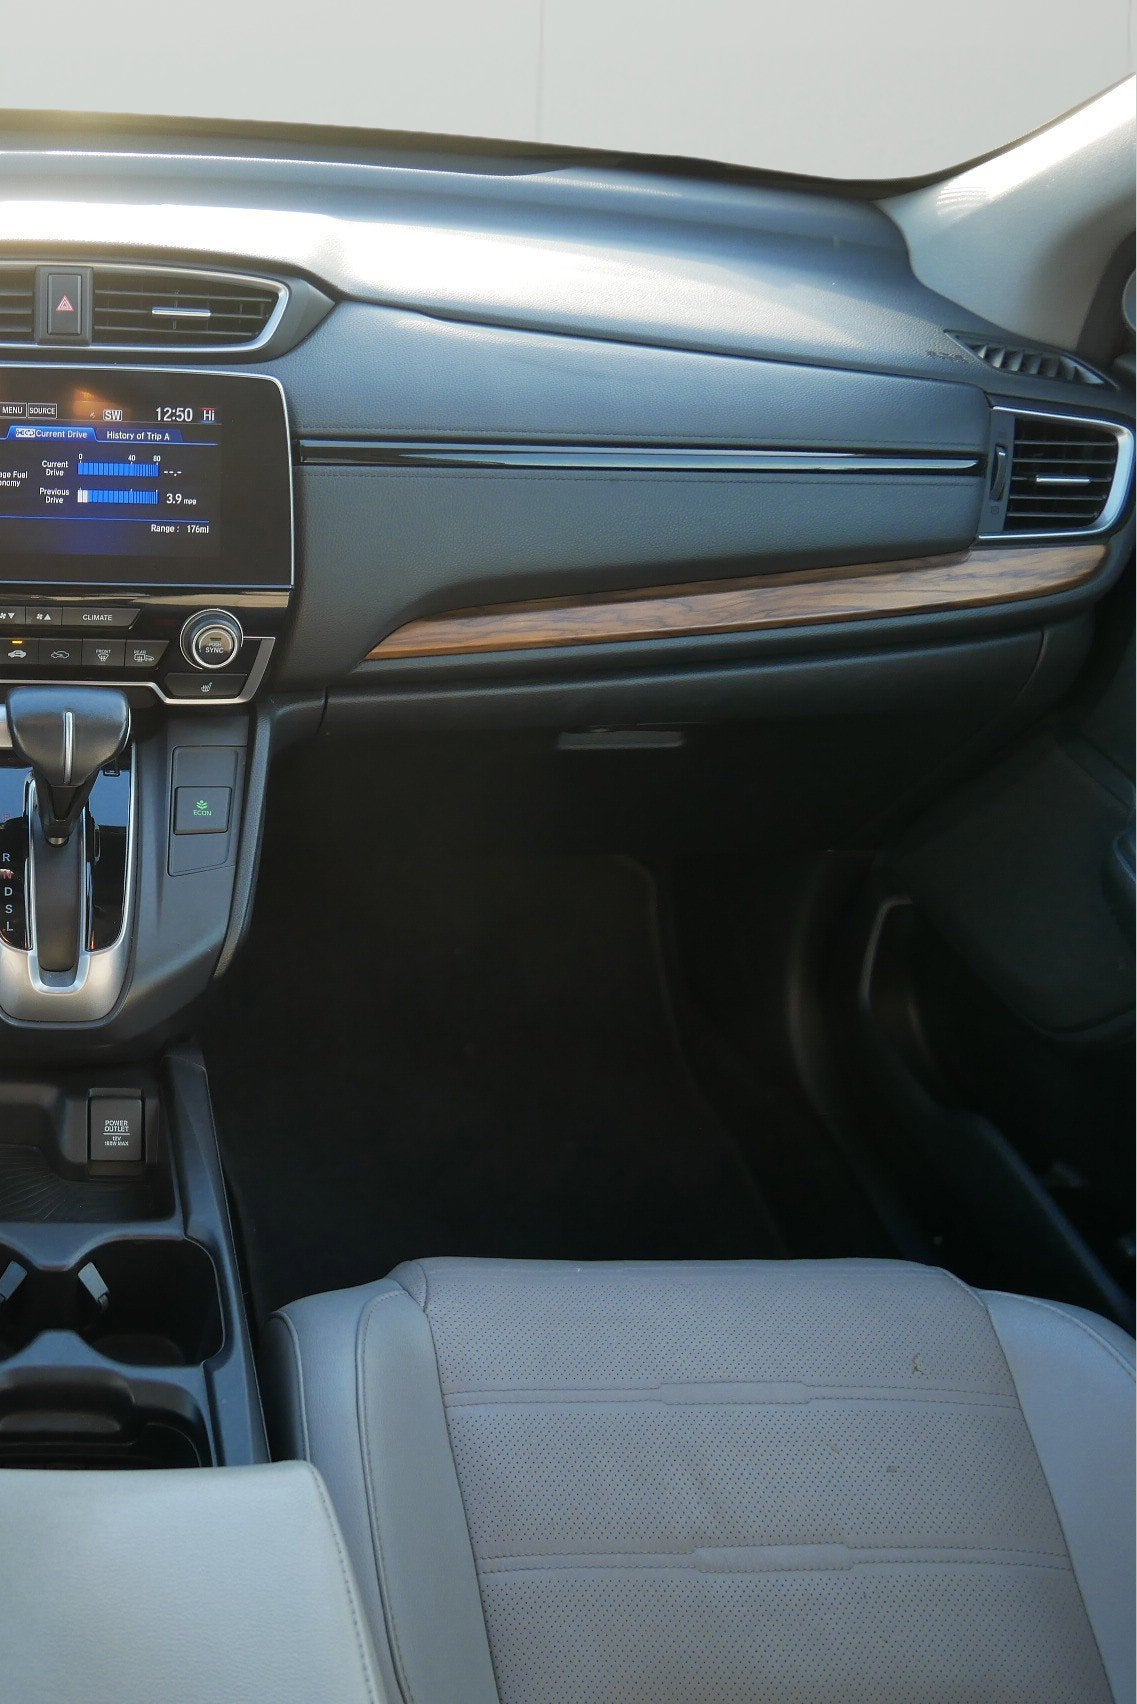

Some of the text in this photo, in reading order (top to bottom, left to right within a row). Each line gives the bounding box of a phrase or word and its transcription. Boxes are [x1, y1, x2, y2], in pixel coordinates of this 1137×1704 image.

[2, 406, 23, 414] MENU
[29, 406, 56, 415] SOURCE
[155, 406, 193, 422] 12:50
[203, 409, 215, 421] Hi
[35, 430, 88, 439] Current Drive
[106, 430, 170, 442] History of Trip A
[41, 460, 69, 468] Current
[12, 470, 28, 478] Fuel
[45, 468, 64, 476] Drive
[39, 487, 70, 496] Previous
[45, 496, 64, 504] Drive
[166, 493, 182, 504] 3.9
[186, 525, 210, 533] 176mi
[205, 647, 225, 655] SYNC
[2, 852, 11, 862] R
[4, 886, 13, 897] D
[5, 904, 13, 914] S
[6, 921, 14, 932] L
